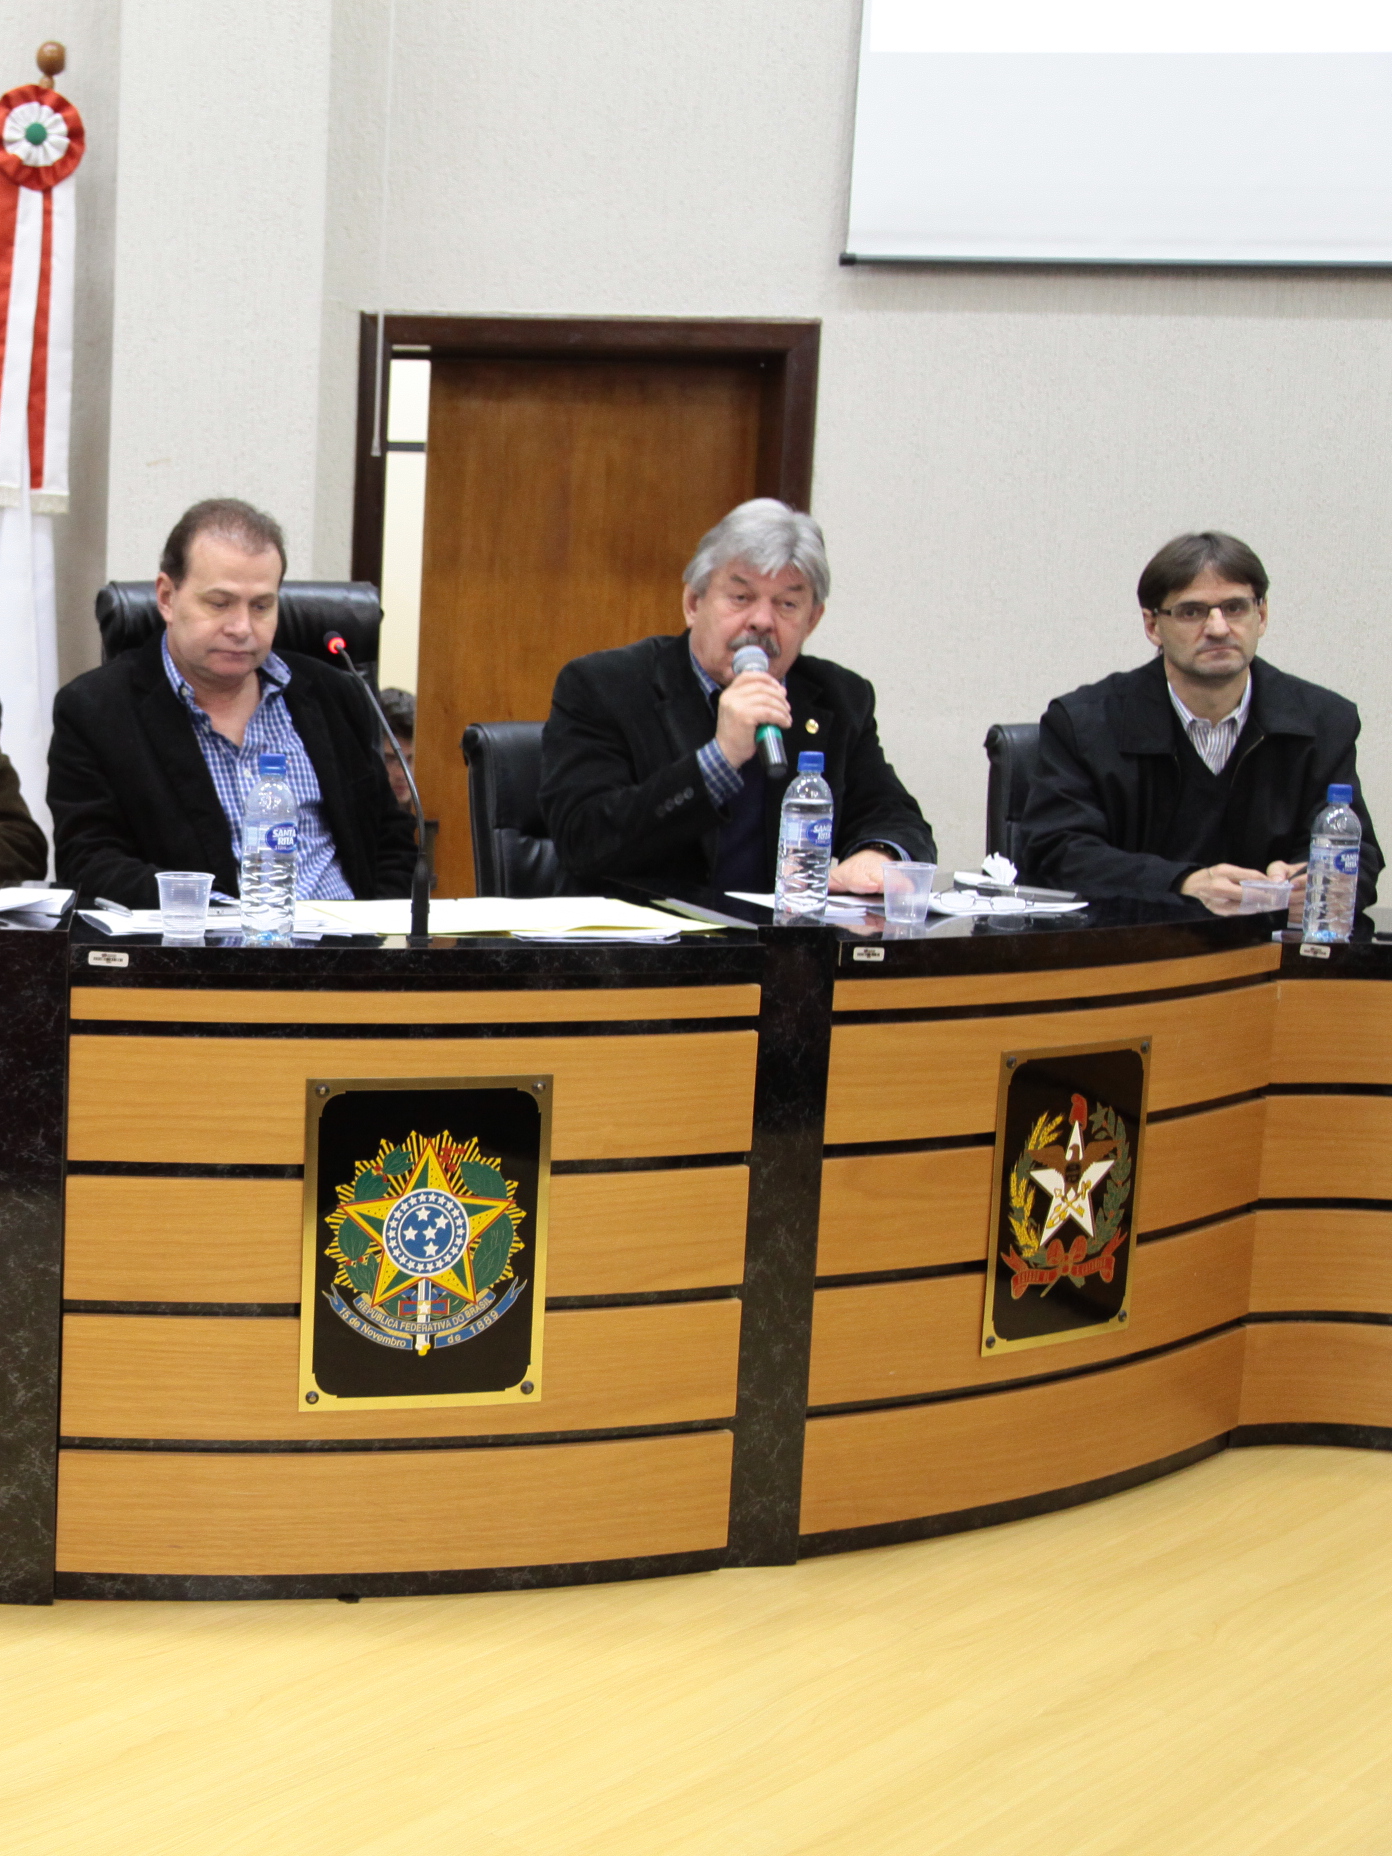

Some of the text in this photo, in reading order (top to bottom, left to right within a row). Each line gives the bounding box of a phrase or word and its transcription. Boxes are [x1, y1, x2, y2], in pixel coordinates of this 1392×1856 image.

[272, 828, 296, 837] SANTA
[277, 837, 294, 845] RITA
[400, 1320, 452, 1332] FEDERATIVA
[452, 1314, 465, 1326] DO
[465, 1297, 494, 1318] BRASIL
[339, 1307, 499, 1347] 15 de Novembro de 1889
